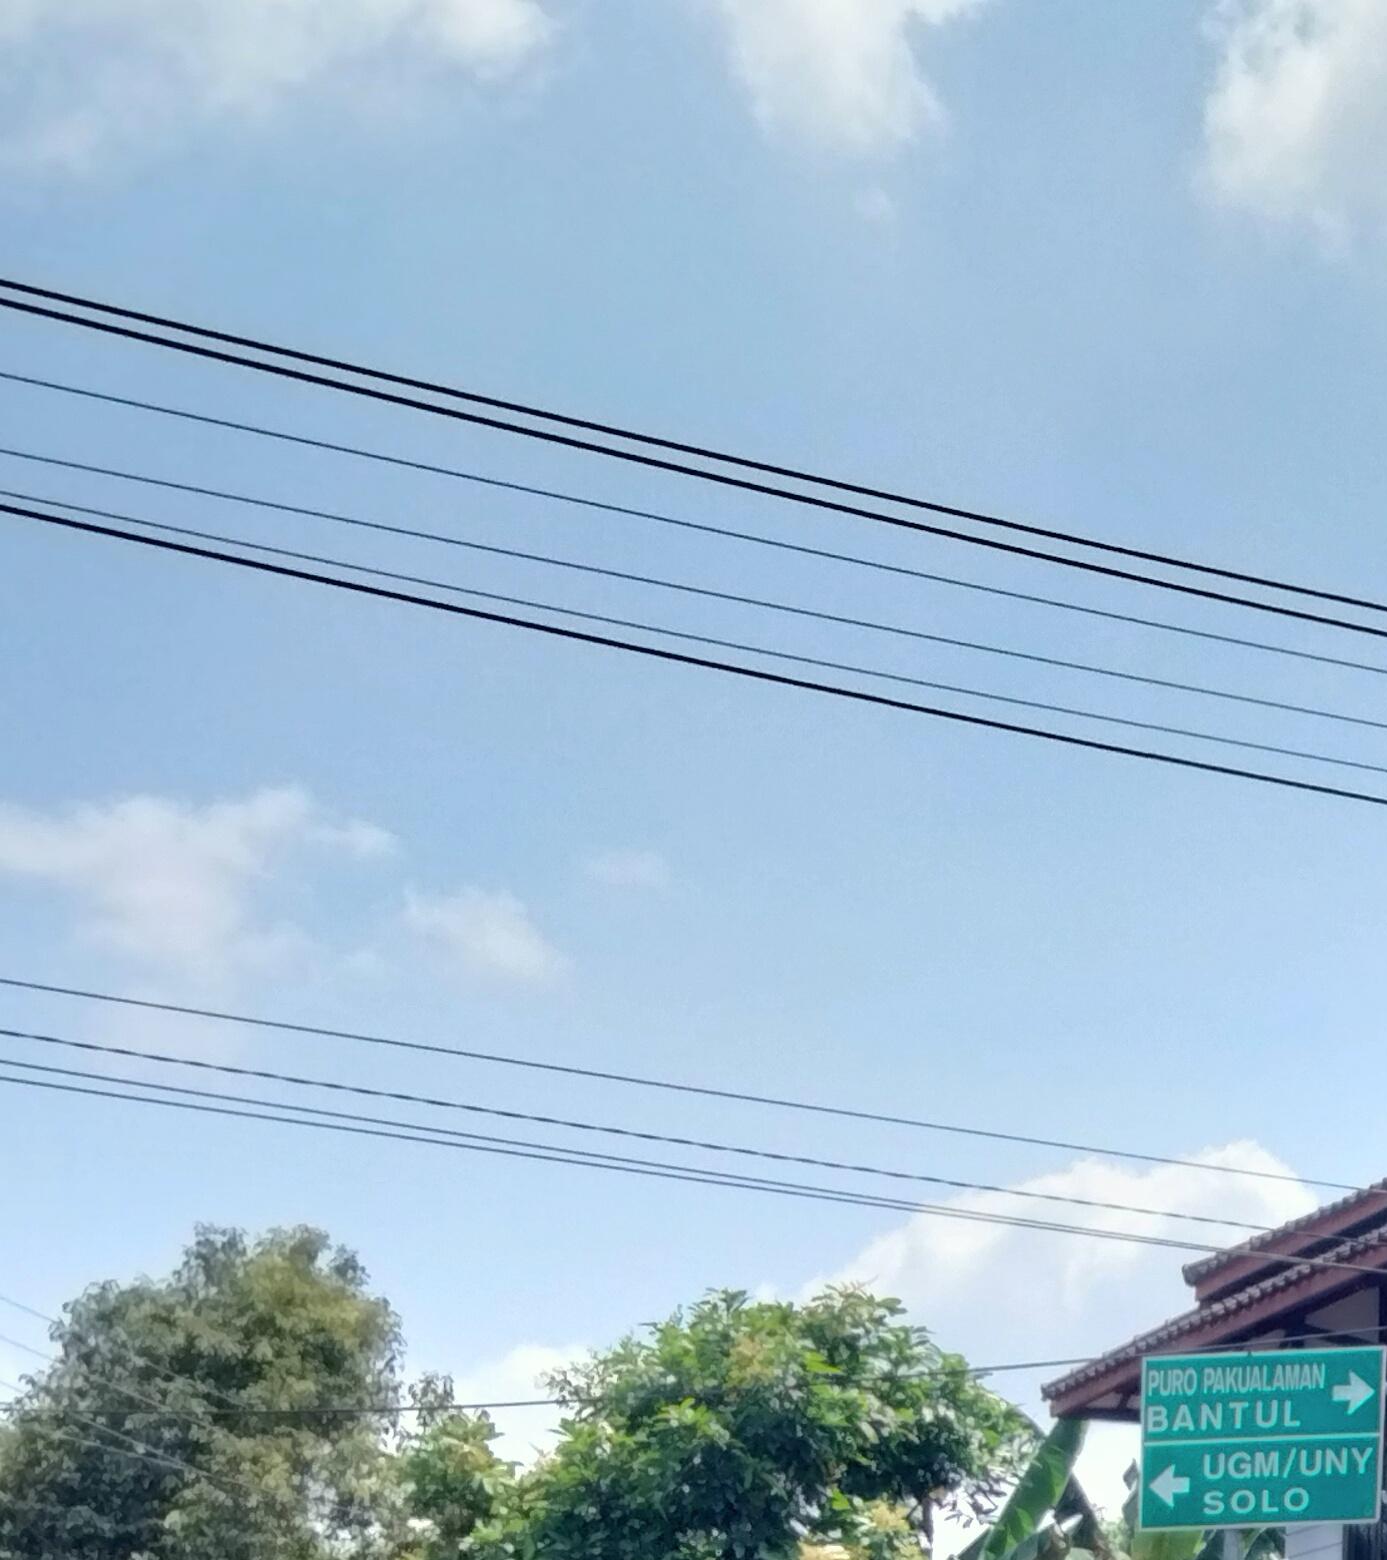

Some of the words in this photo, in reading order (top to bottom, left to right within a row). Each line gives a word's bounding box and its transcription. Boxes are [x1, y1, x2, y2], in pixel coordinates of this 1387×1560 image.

[1147, 1368, 1198, 1397] PURO
[1203, 1363, 1326, 1394] PAKUALAMAN
[1147, 1400, 1301, 1433] BANTUL
[1202, 1447, 1374, 1480] UGM/UNY
[1203, 1487, 1310, 1515] SOLO
